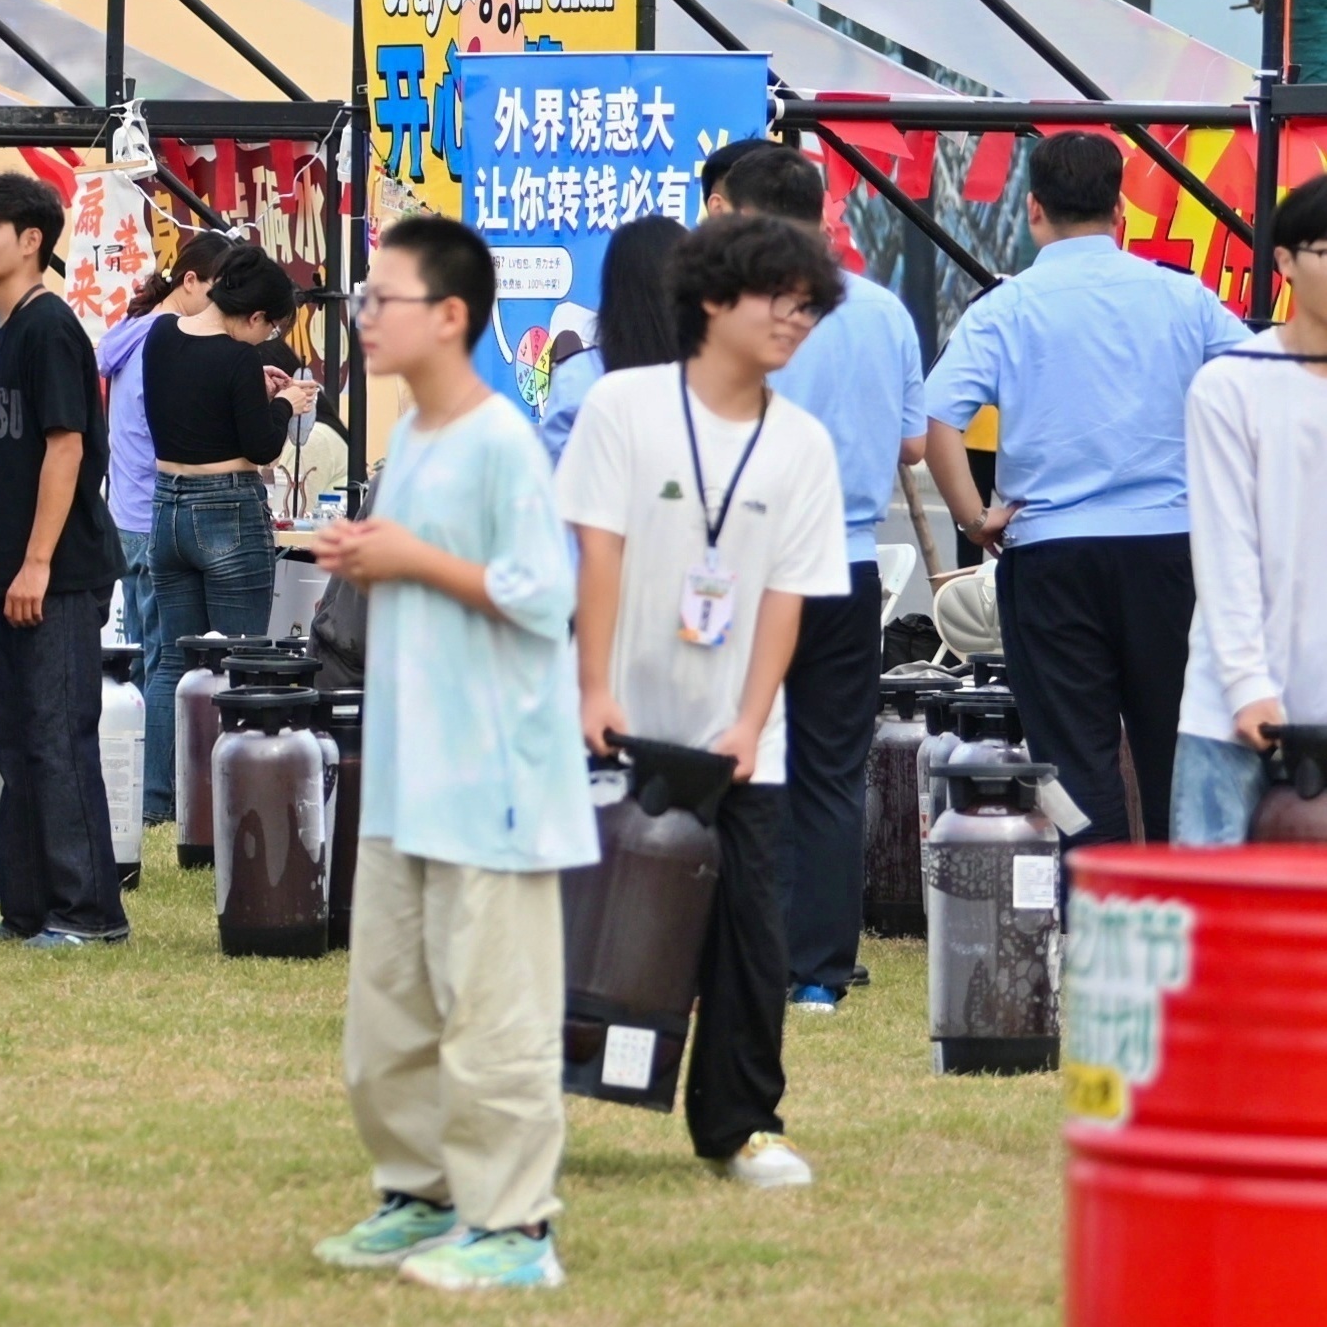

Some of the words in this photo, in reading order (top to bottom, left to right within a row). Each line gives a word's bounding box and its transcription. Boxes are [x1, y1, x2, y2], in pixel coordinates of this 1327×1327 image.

[494, 85, 676, 154] 外界诱惑大
[474, 164, 691, 232] 让你转钱必有
